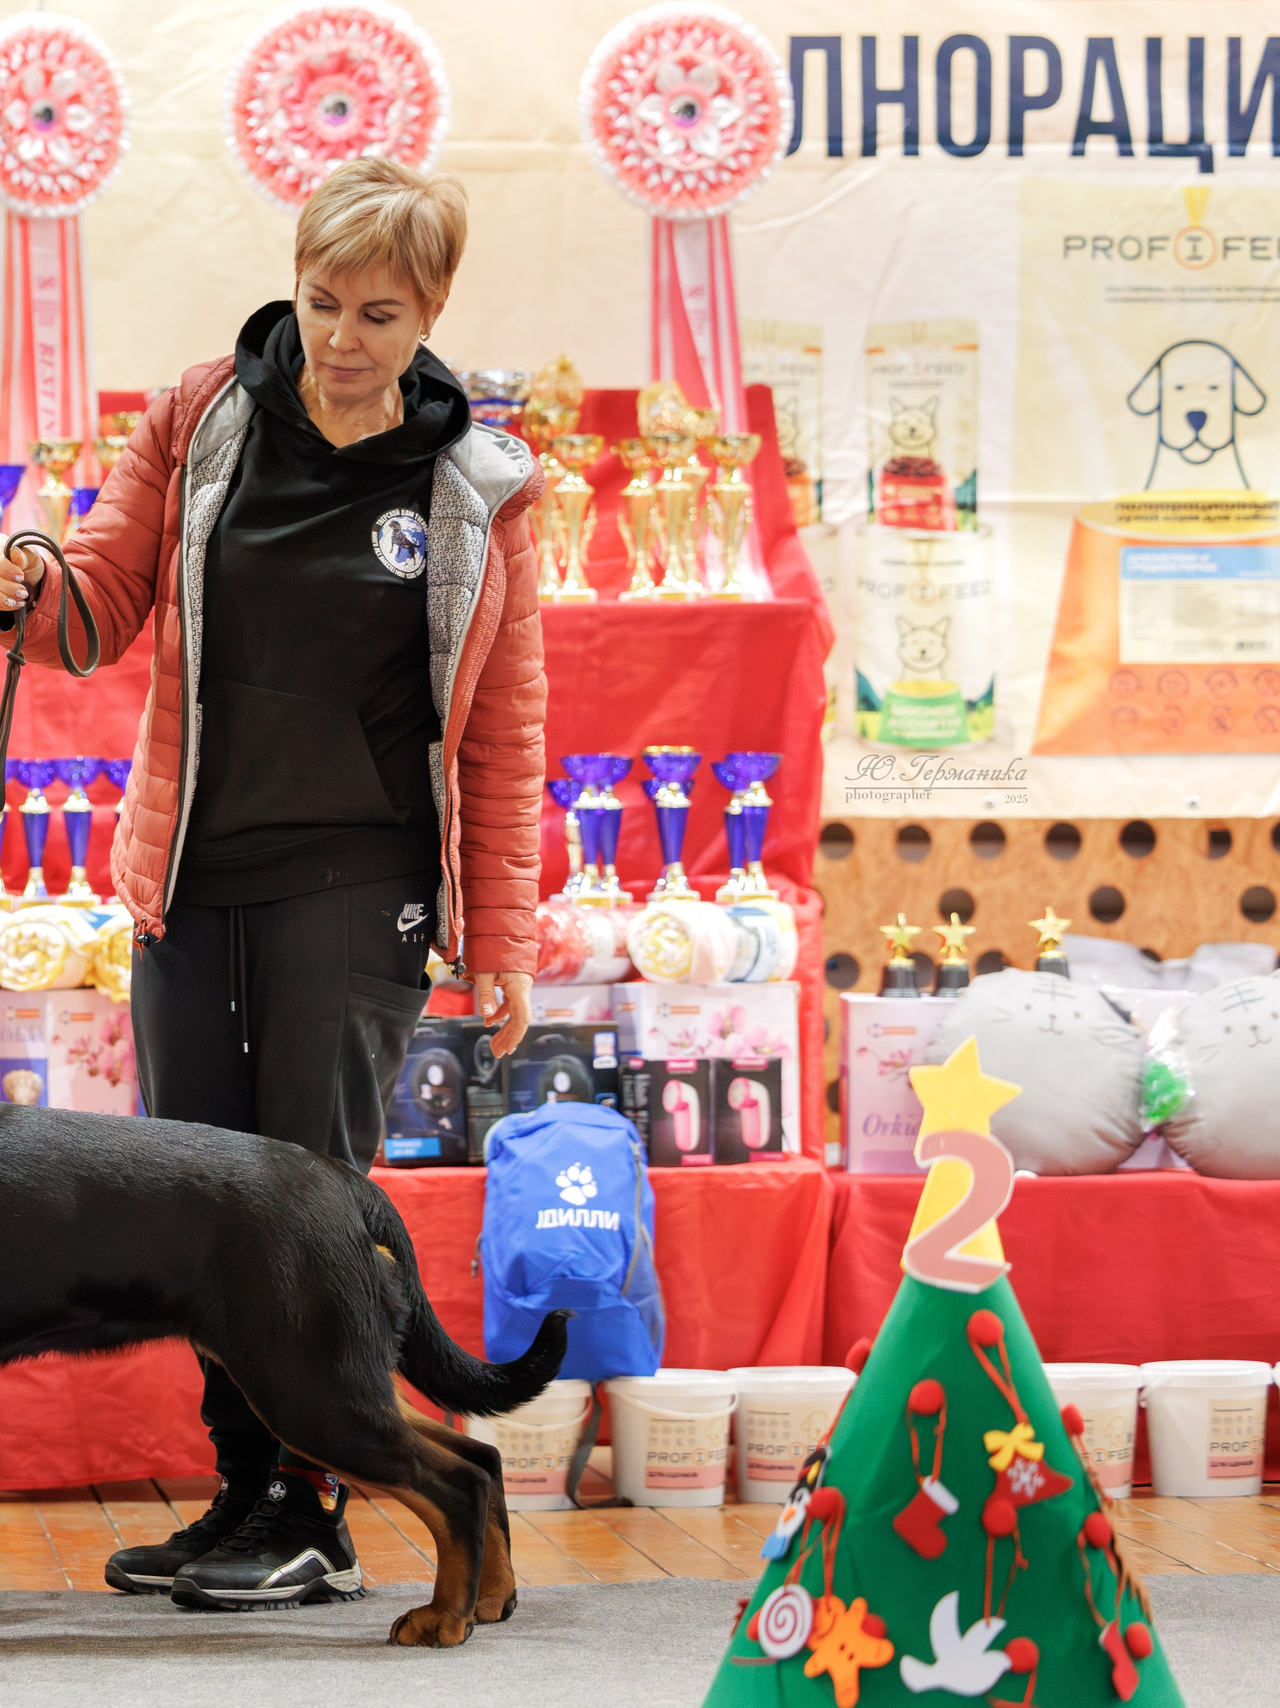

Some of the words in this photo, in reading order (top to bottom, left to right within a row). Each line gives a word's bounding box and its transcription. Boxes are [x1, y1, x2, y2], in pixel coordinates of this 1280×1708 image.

[1063, 235, 1280, 261] PROFIFE
[401, 903, 424, 919] NIKE
[904, 1129, 1014, 1293] 2
